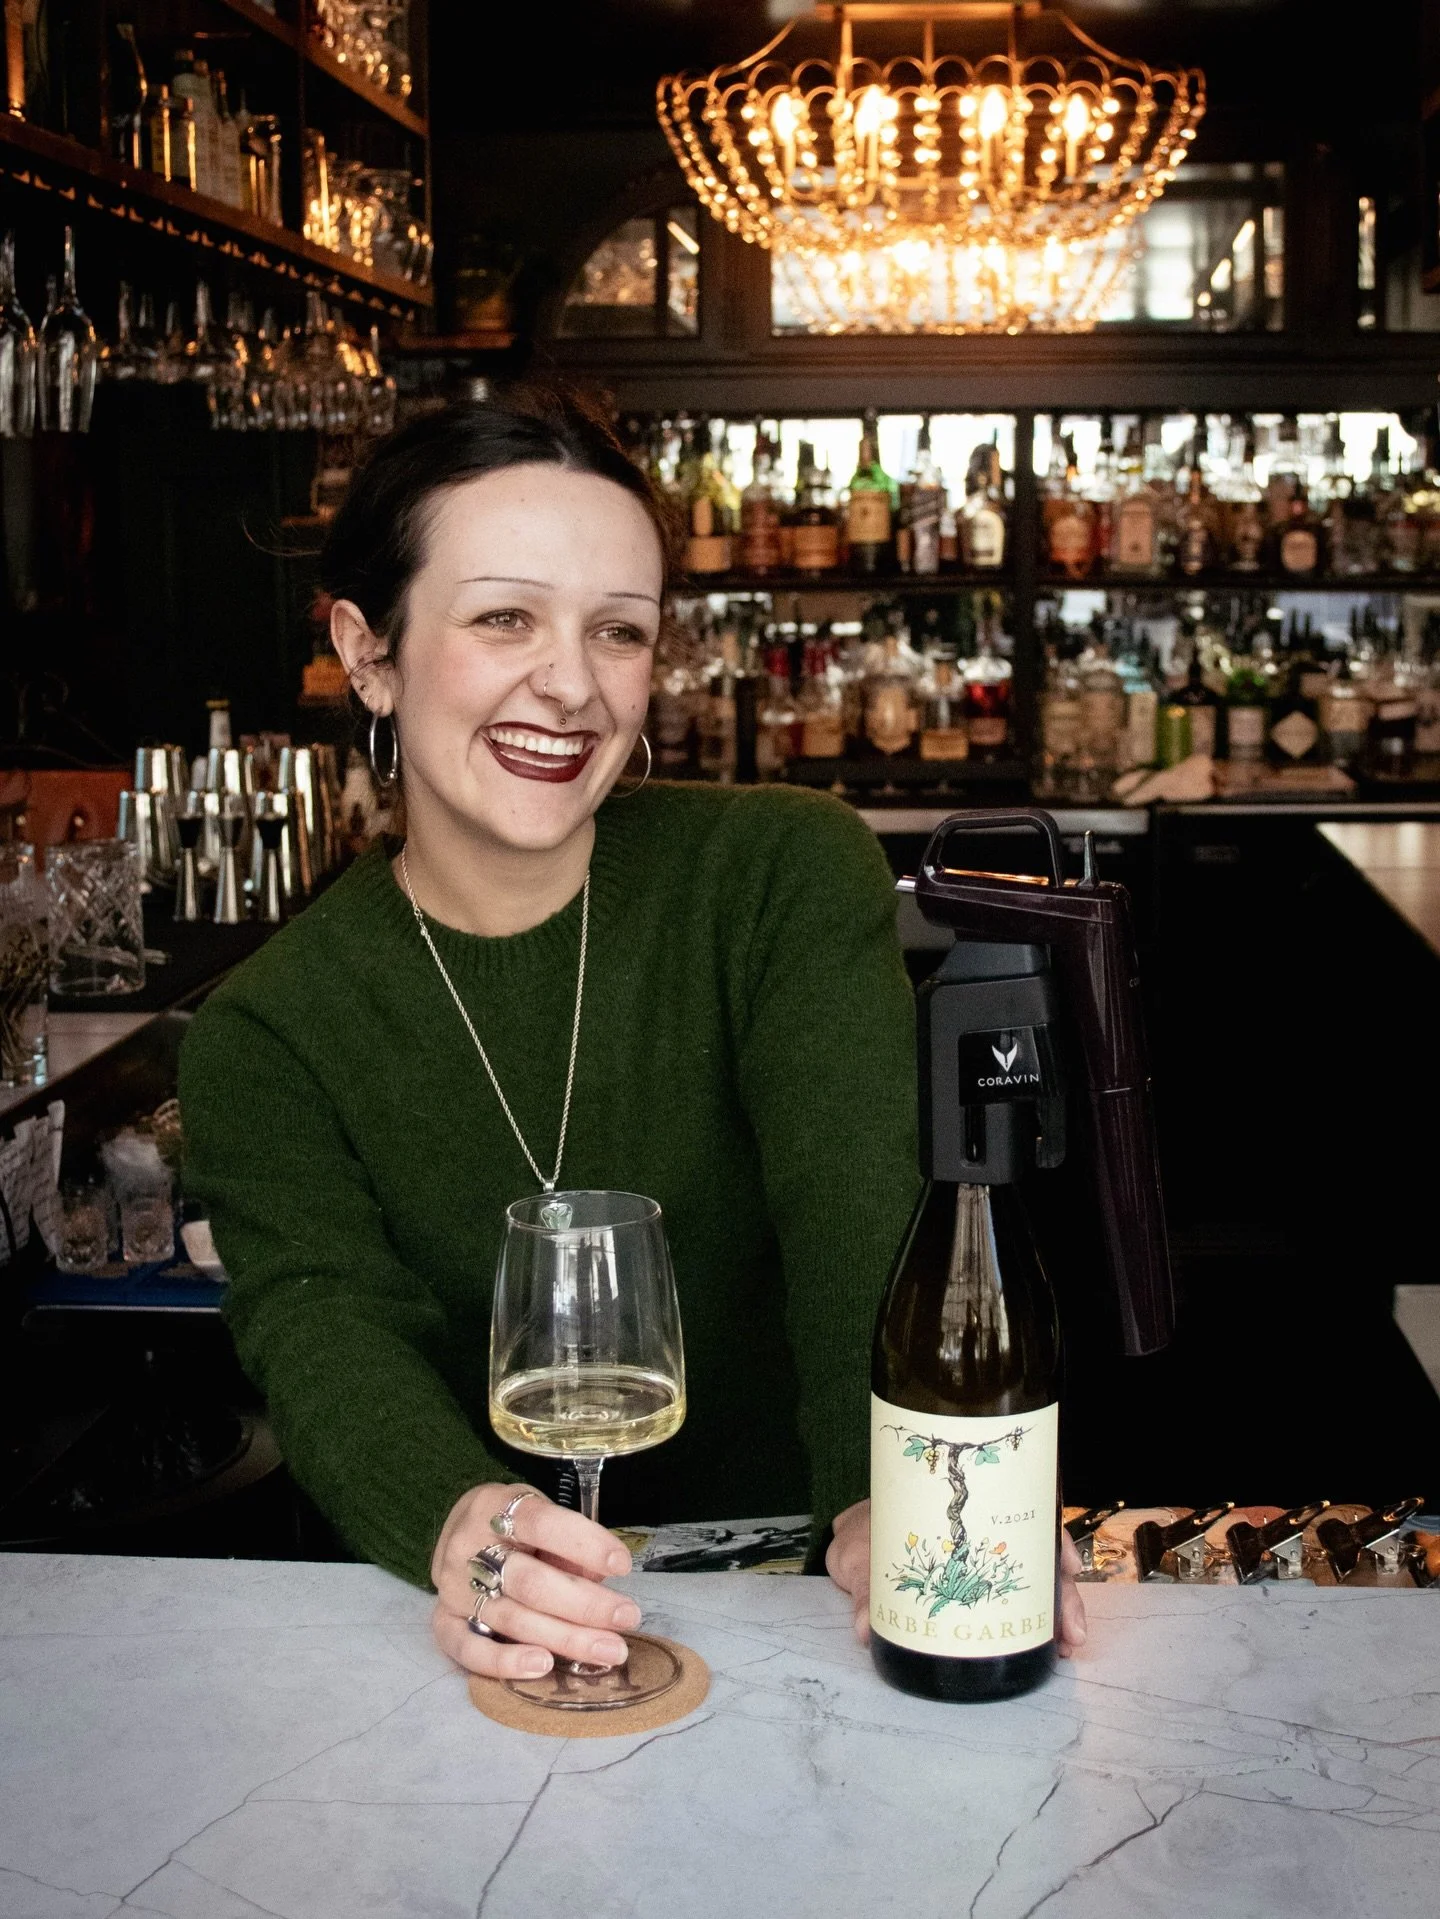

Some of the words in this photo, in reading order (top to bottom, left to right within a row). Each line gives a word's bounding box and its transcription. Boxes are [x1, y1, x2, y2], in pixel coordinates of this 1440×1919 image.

[977, 1073, 1040, 1087] CORAVIN
[990, 1509, 1036, 1525] V.2021
[876, 1603, 938, 1639] ARBE
[953, 1611, 1048, 1641] GARBE
